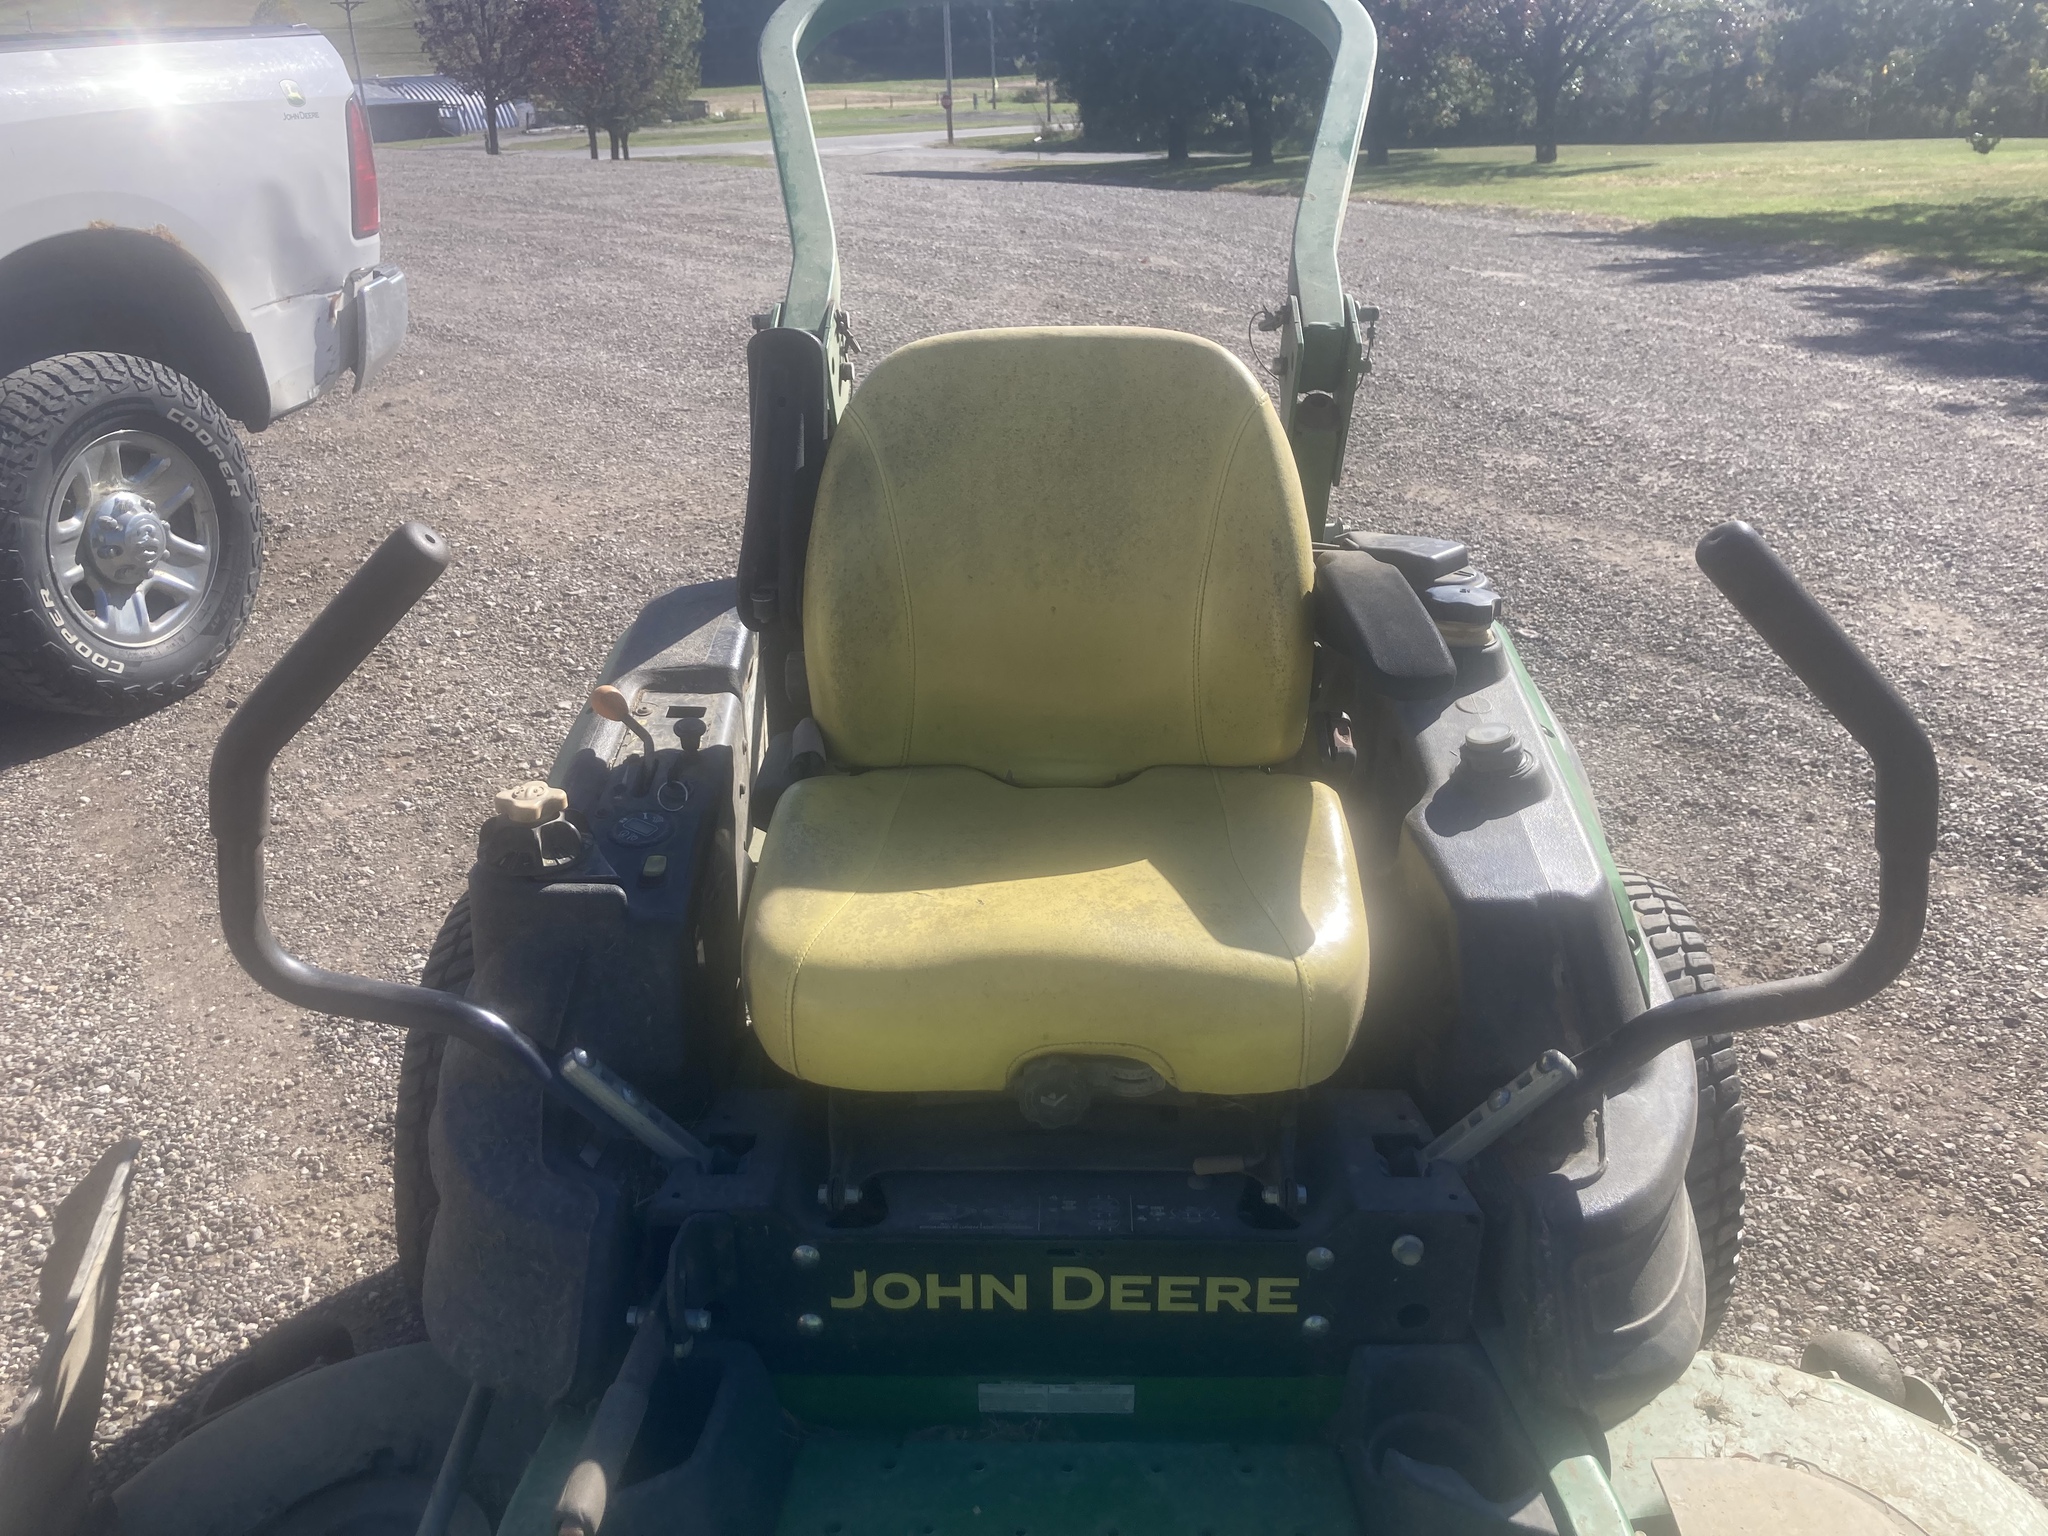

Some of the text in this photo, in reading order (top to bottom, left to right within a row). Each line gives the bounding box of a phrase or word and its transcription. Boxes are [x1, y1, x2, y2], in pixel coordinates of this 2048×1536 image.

[283, 112, 299, 120] JOHN
[166, 407, 241, 497] COOPER
[40, 588, 125, 674] COOPER
[830, 1266, 1300, 1313] JOHN DEERE
